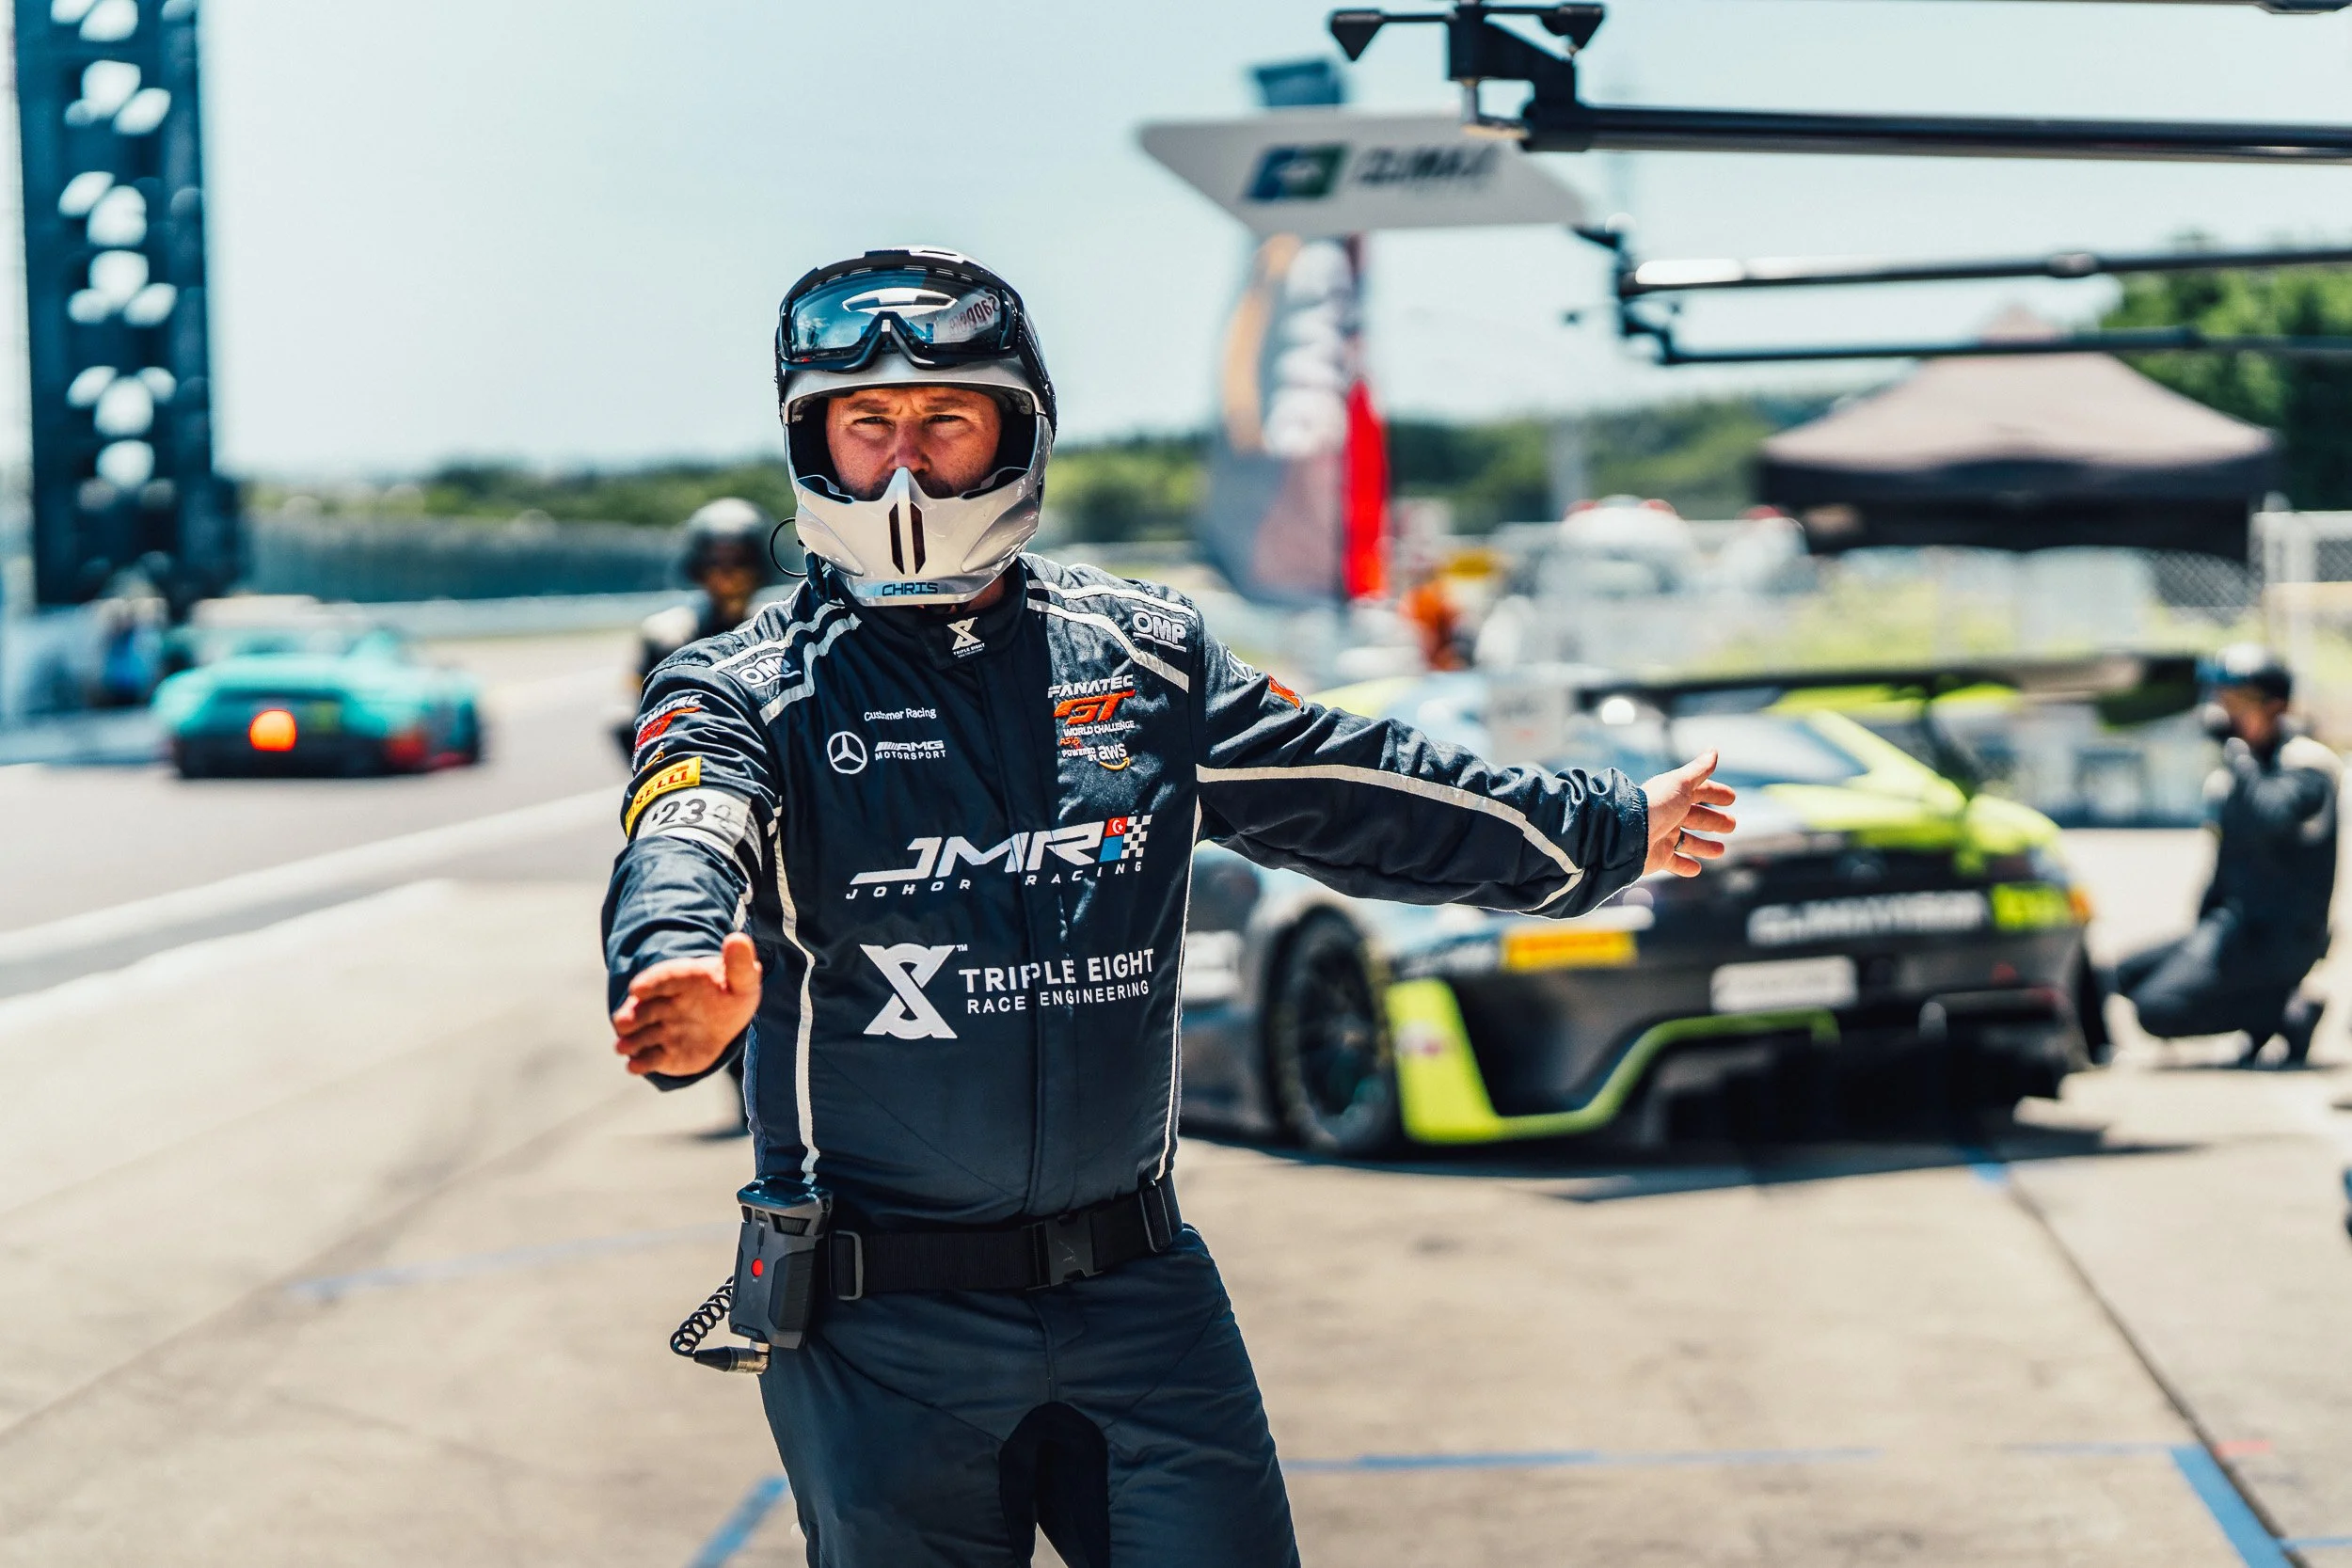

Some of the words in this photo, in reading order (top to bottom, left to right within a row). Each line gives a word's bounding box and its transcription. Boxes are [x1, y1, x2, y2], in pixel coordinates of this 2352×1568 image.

[882, 581, 939, 596] CHRIS
[1132, 611, 1187, 644] OMP
[953, 646, 970, 656] TRIPLE
[739, 657, 791, 685] OMP
[1047, 674, 1134, 698] FANATEC
[864, 709, 904, 721] Customer
[905, 707, 937, 720] Racing
[1053, 689, 1136, 725] GT
[1063, 726, 1093, 737] WORLD
[1094, 721, 1136, 734] CHALLENGE
[874, 750, 946, 761] MOTORSPORT
[890, 739, 945, 752] AMG
[1097, 742, 1127, 761] aws
[849, 821, 1104, 885] JMR
[845, 879, 972, 900] JOHOR
[1025, 861, 1142, 887] RACING
[958, 958, 1077, 993] TRIPLE
[1087, 948, 1154, 982] EIGHT
[967, 995, 1026, 1015] RACE
[1040, 979, 1150, 1006] ENGINEERING
